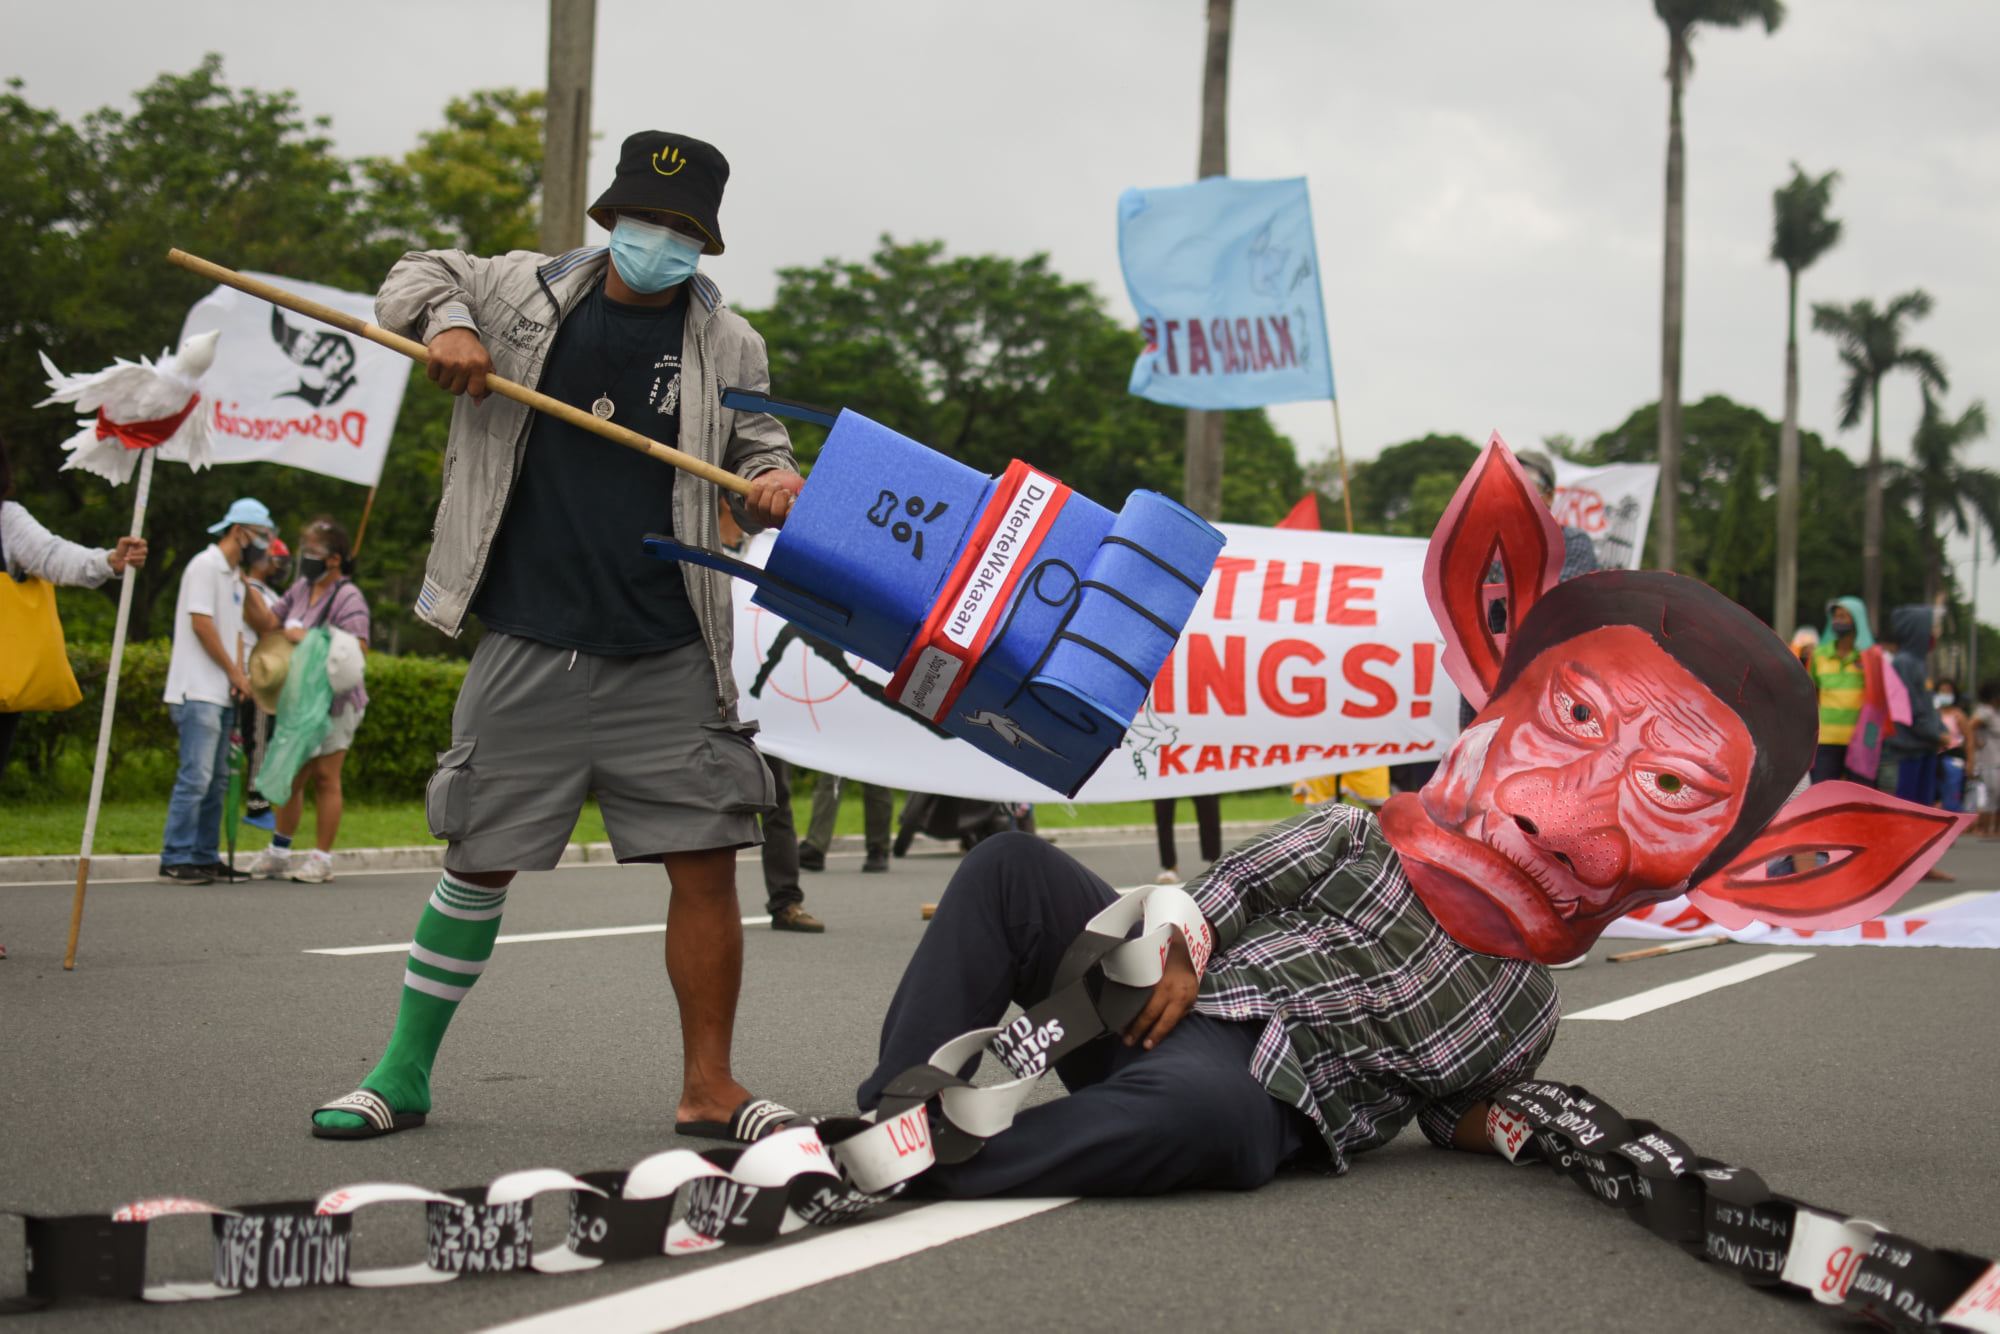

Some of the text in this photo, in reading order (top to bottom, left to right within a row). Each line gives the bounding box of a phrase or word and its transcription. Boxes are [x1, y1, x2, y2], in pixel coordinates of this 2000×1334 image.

[648, 376, 661, 405] ARMY
[653, 361, 682, 369] NATIONA
[950, 483, 1045, 636] DuterteWakasan
[1213, 556, 1384, 627] THE
[1138, 632, 1435, 719] INGS!
[1749, 1208, 1787, 1238] May
[265, 1234, 349, 1289] ARLITO
